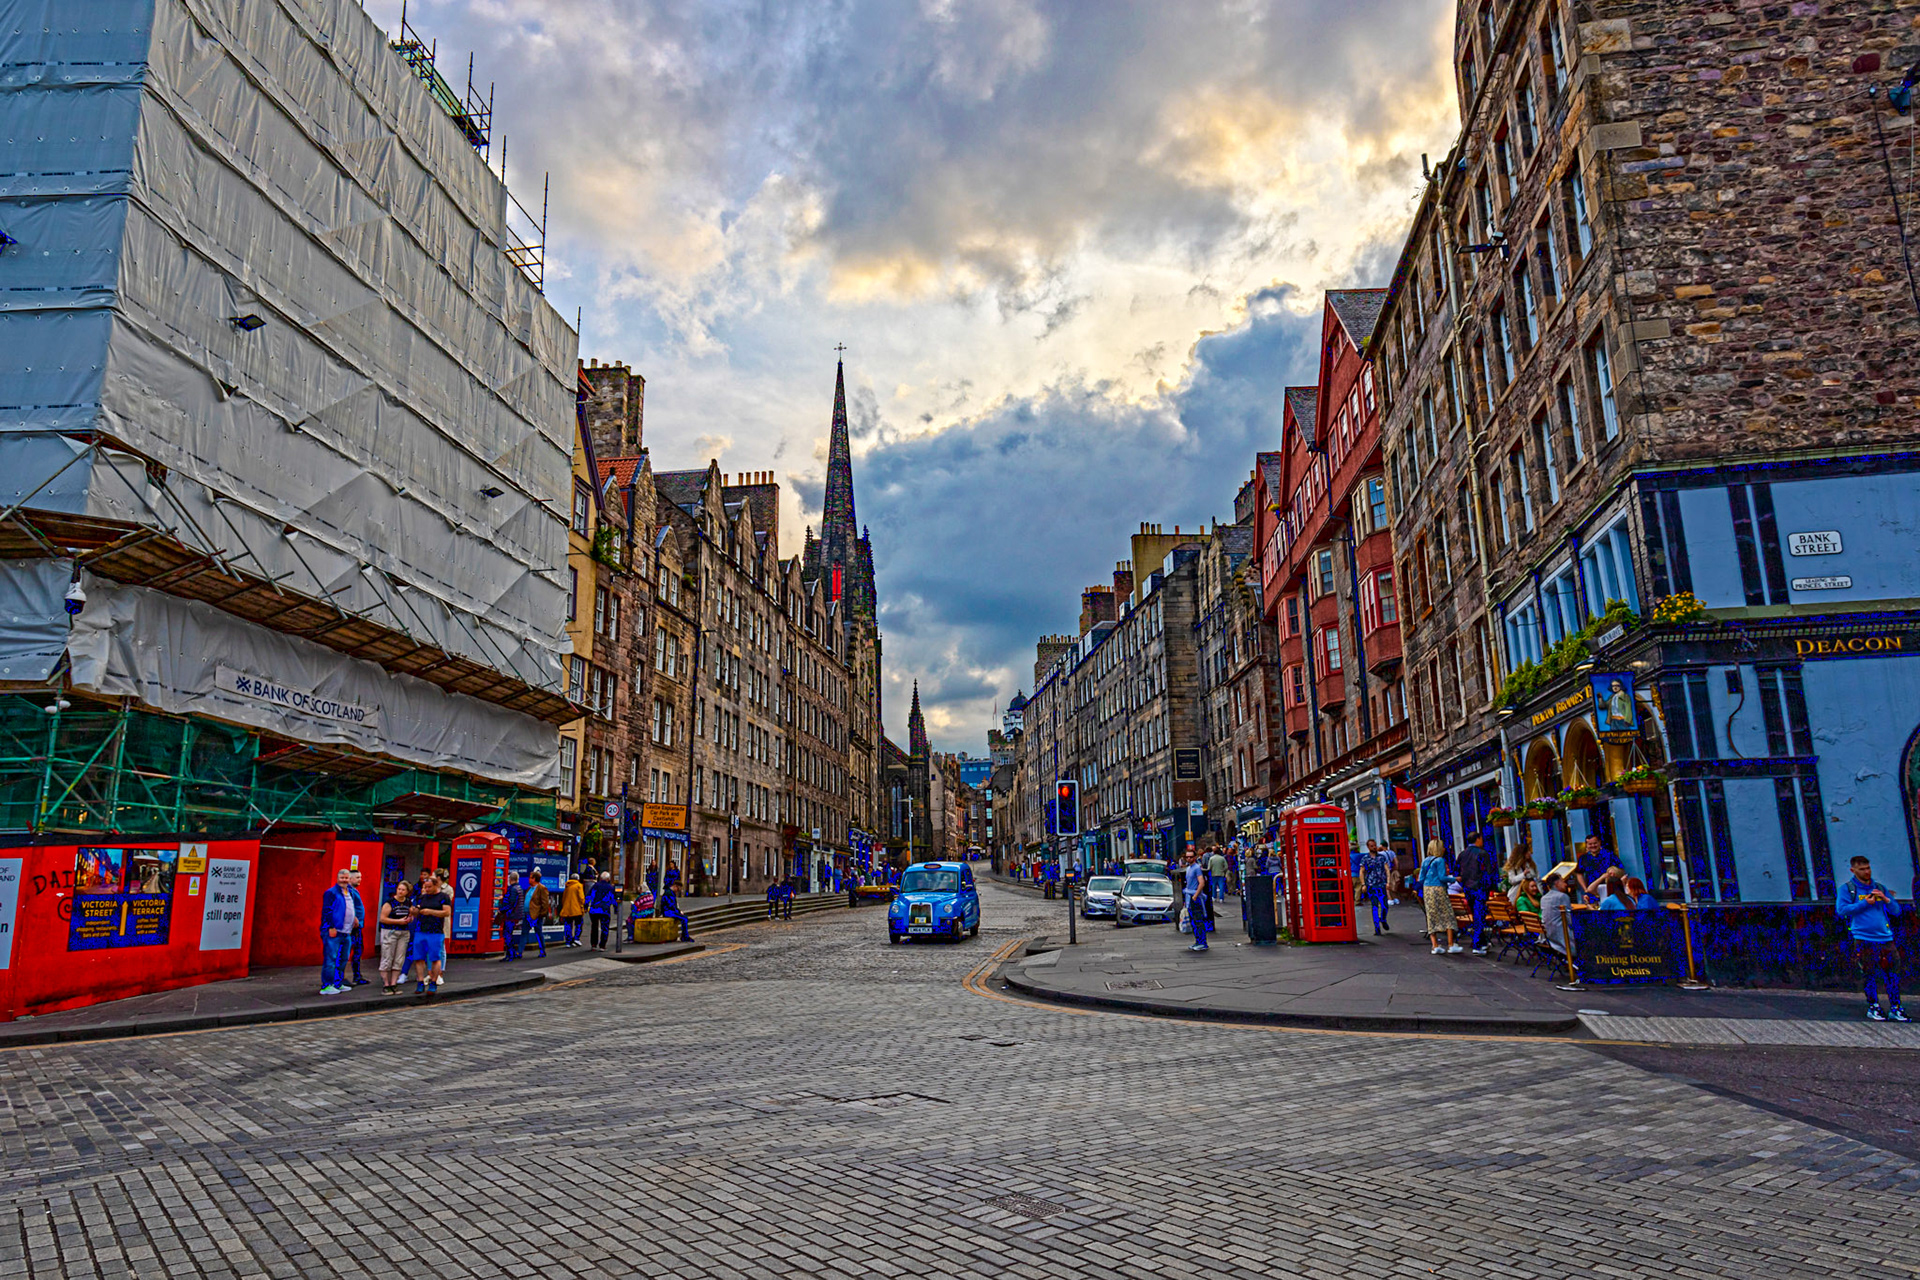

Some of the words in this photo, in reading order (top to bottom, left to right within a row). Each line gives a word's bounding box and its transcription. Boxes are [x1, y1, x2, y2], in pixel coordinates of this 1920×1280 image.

[1799, 534, 1831, 544] BANK
[1794, 543, 1838, 554] STREET
[1794, 636, 1902, 655] DEACON
[254, 680, 290, 703] BANK
[292, 692, 310, 708] OF
[310, 697, 365, 722] SCOTLAND
[214, 892, 225, 903] We
[226, 894, 238, 903] are
[85, 909, 113, 917] STREET
[133, 907, 164, 915] TERRACE
[206, 909, 222, 920] still
[224, 912, 241, 923] open
[1596, 955, 1628, 966] Dining
[1630, 955, 1661, 963] Room
[1611, 967, 1651, 978] Upstairs
